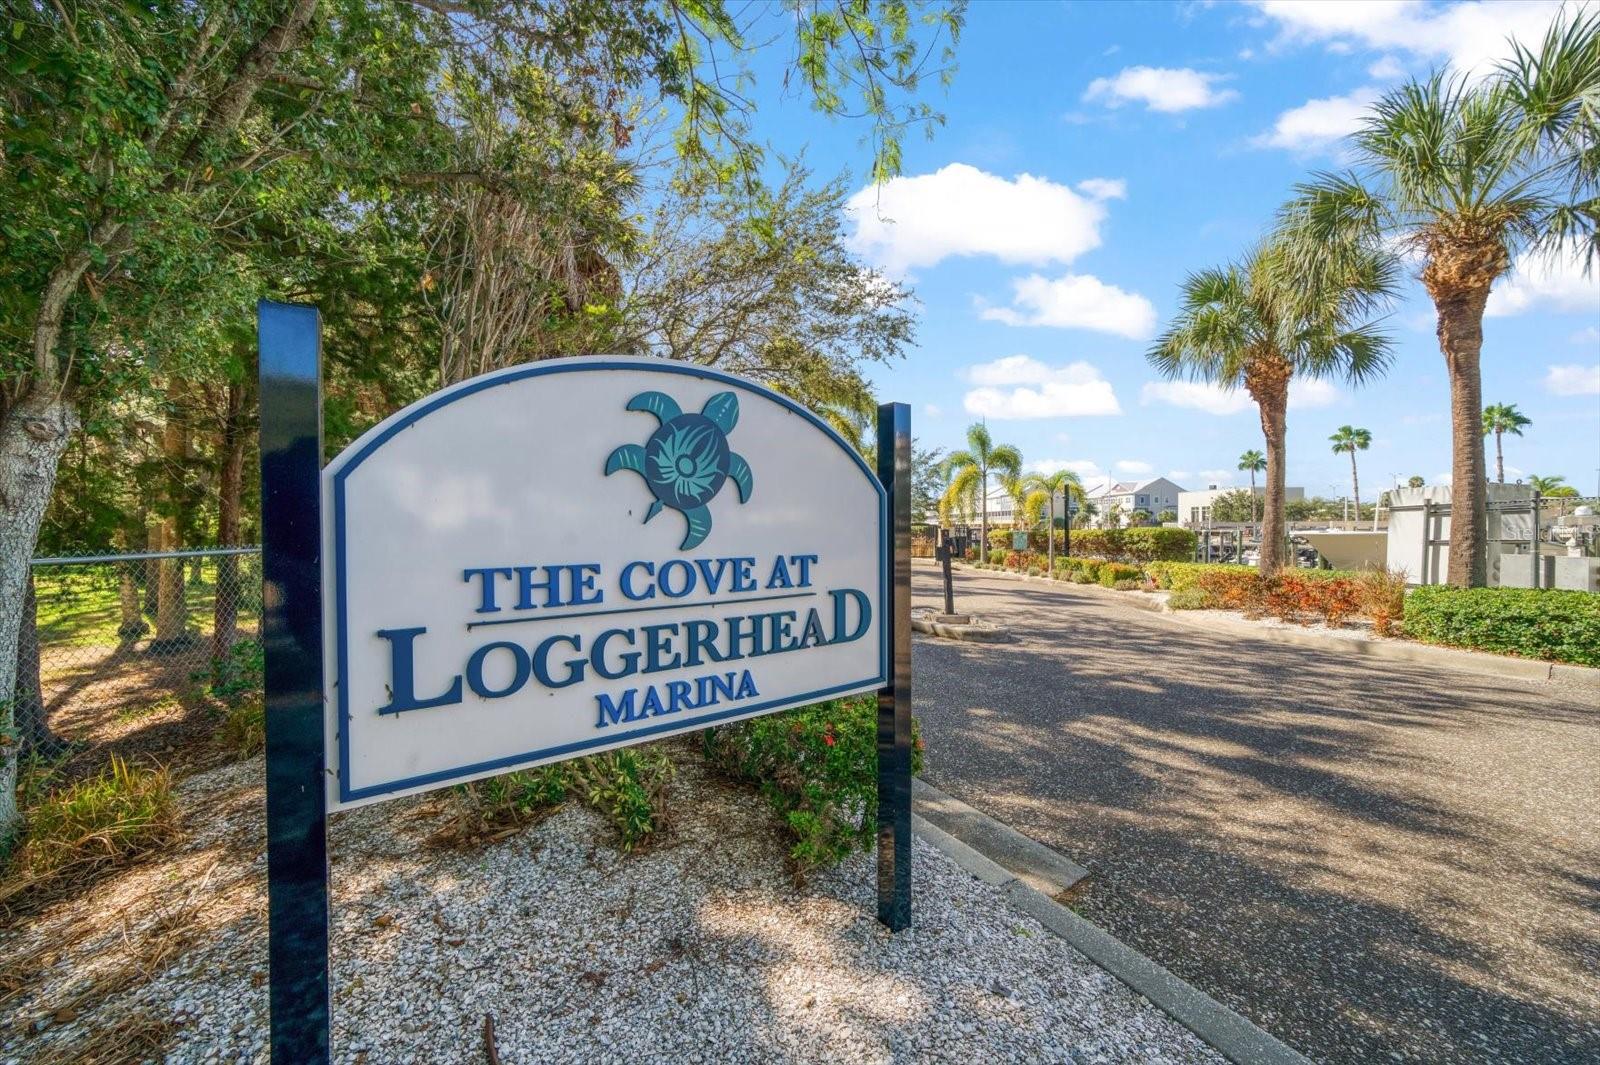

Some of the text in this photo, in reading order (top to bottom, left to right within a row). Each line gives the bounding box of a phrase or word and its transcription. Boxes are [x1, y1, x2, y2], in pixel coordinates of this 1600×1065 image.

[463, 555, 818, 613] THE COVE AT
[377, 588, 872, 716] LOGGERHEAD
[595, 669, 760, 728] MARINA
